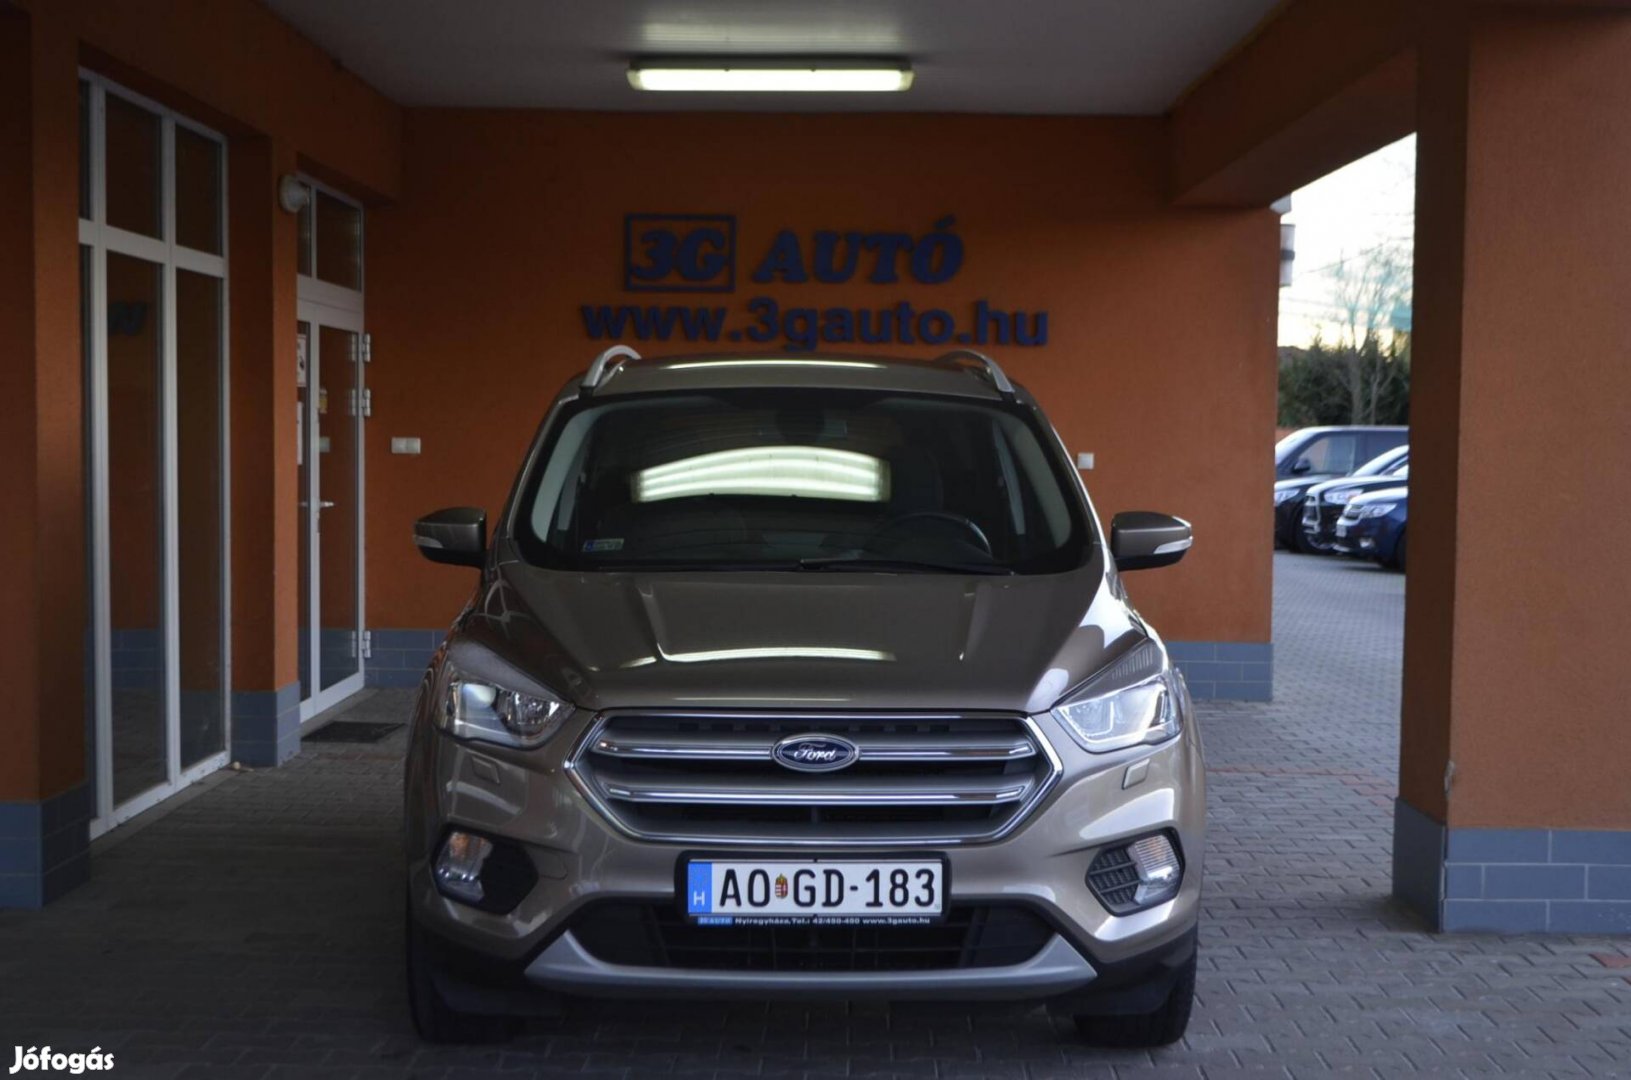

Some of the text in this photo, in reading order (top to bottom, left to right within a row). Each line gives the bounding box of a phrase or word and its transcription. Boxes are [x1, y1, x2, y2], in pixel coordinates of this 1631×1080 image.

[630, 214, 965, 285] 3G AUTÓ
[581, 296, 1048, 350] www.3gauto.hu
[793, 742, 837, 761] Ford
[692, 890, 706, 907] H
[793, 868, 936, 908] GD-183
